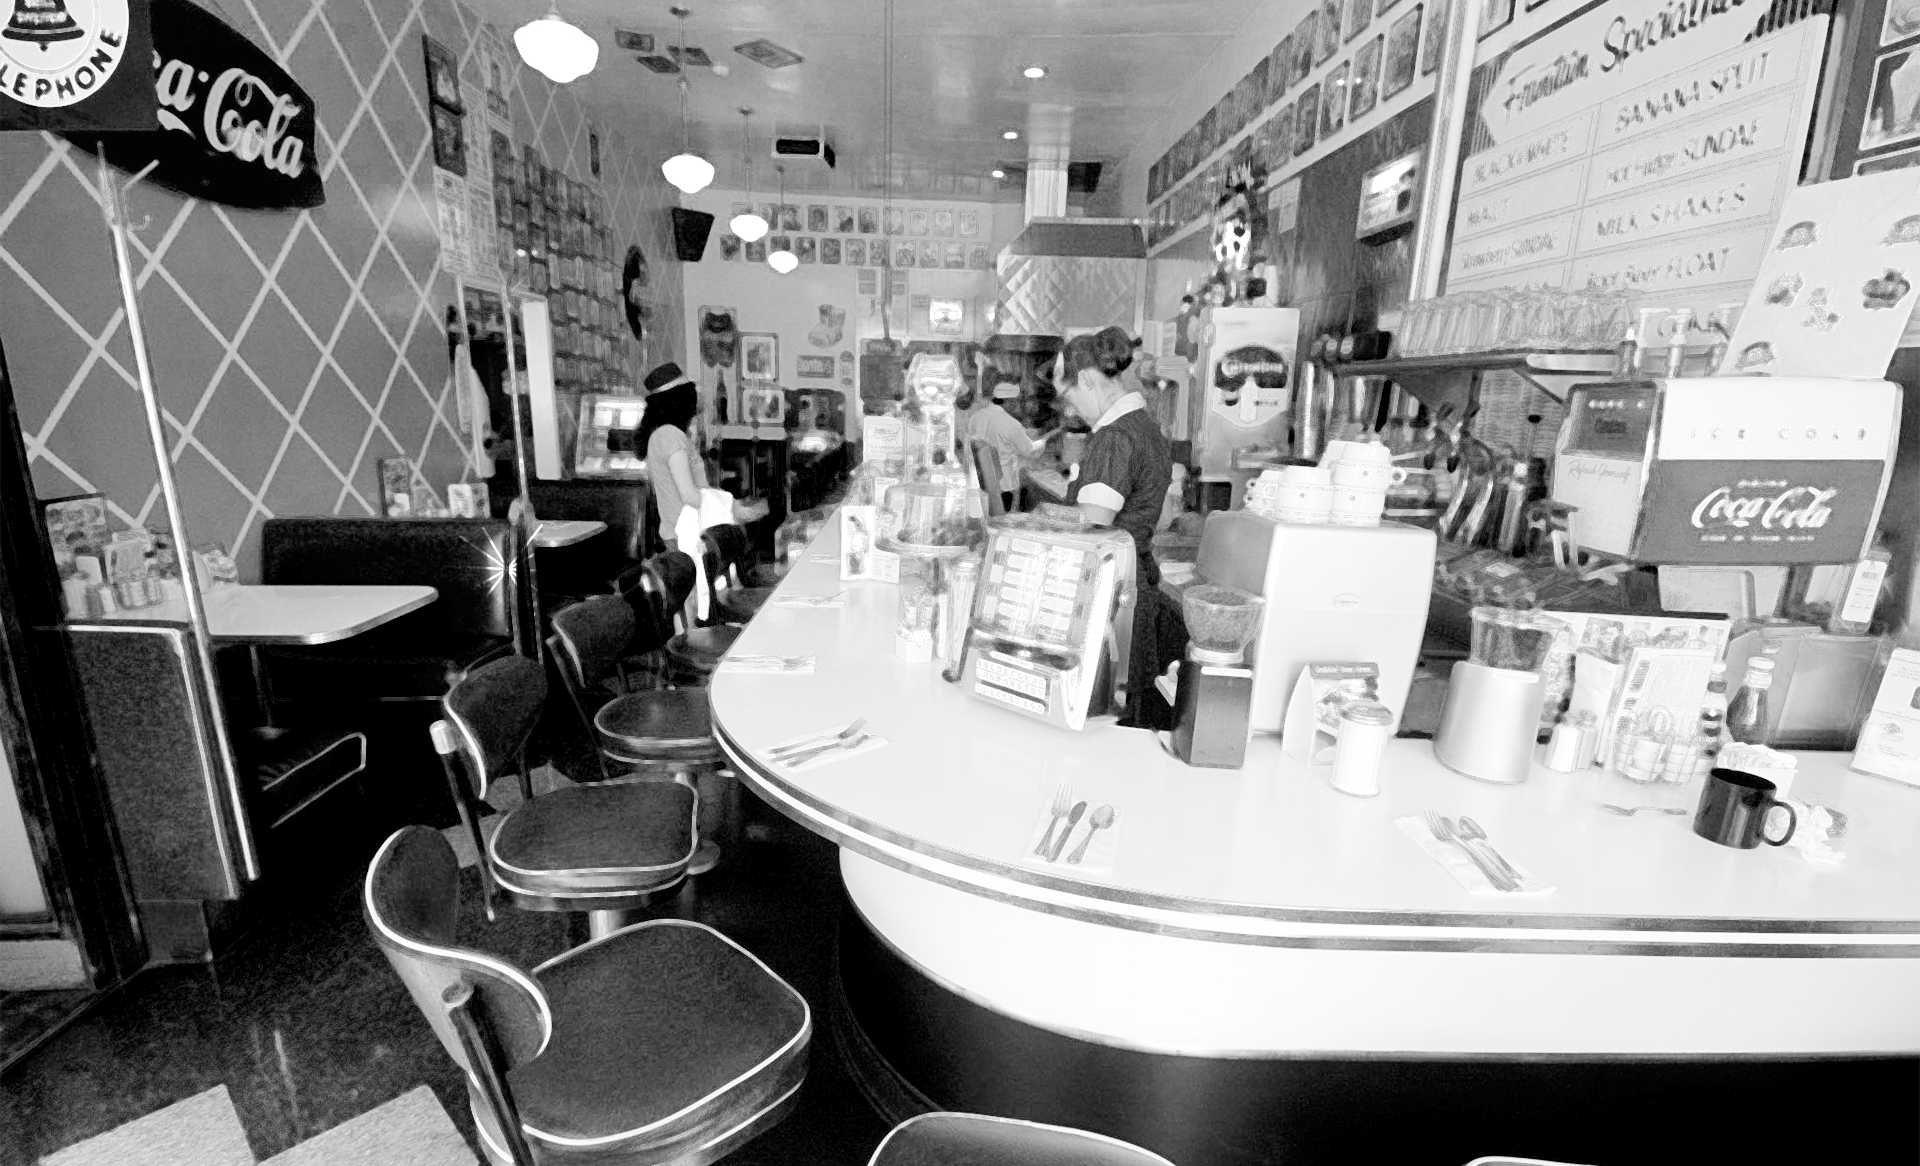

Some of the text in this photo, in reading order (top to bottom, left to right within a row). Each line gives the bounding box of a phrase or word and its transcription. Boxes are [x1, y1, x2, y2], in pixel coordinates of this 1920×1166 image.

[1614, 49, 1773, 134] BANANA SPLIT
[1680, 115, 1764, 166] SUNDAE
[1467, 197, 1512, 229] MALT
[1595, 182, 1749, 240] MILK SHAKES
[1664, 245, 1735, 282] FLOAT
[1689, 425, 1747, 441] ICE
